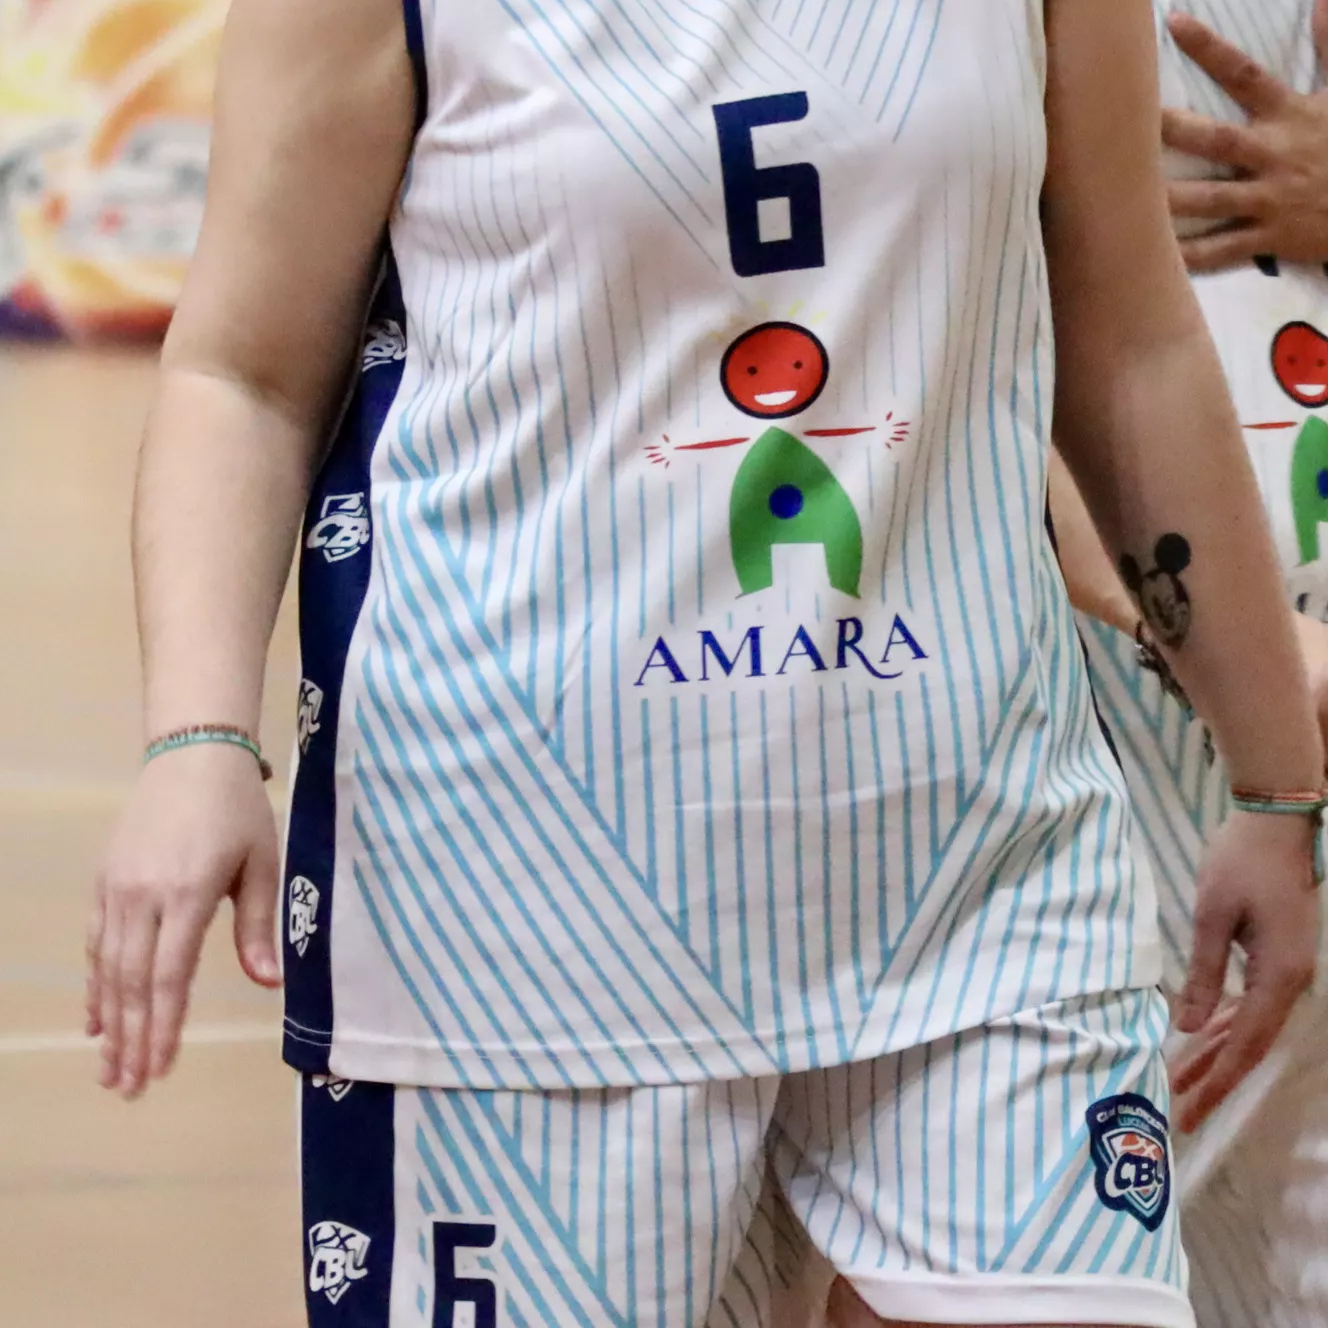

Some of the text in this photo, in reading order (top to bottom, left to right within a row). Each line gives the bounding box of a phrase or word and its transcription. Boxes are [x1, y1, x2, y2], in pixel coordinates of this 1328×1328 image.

[712, 90, 826, 278] 6
[634, 613, 928, 686] AMARA
[432, 1221, 496, 1328] 6
